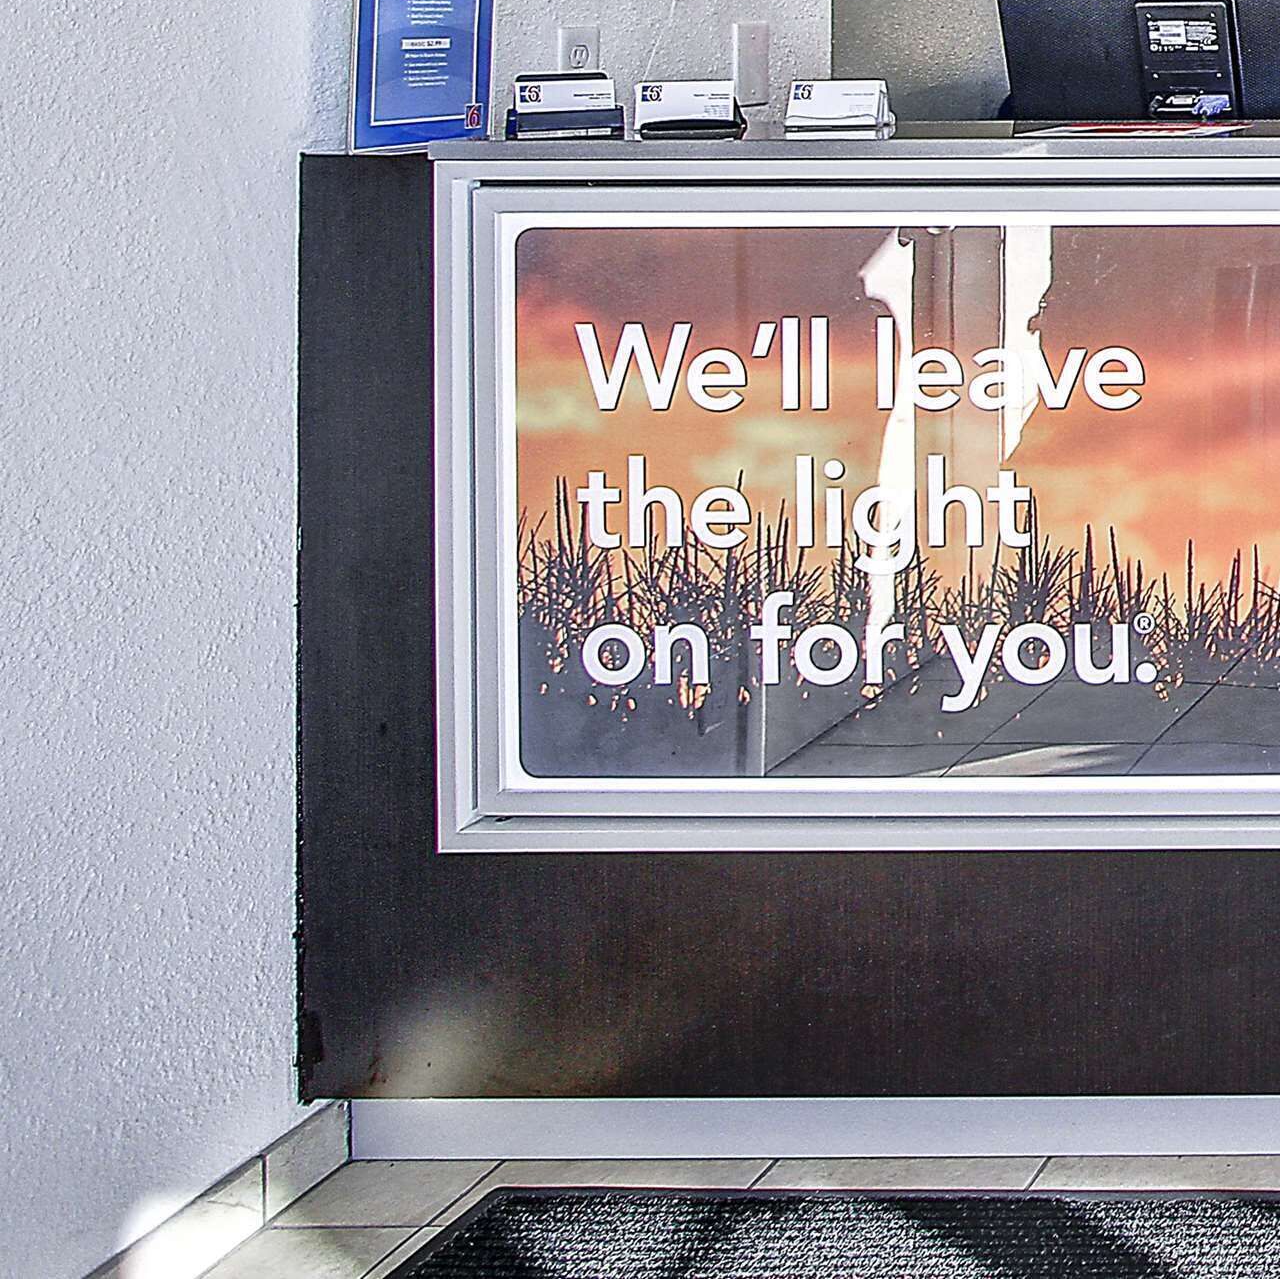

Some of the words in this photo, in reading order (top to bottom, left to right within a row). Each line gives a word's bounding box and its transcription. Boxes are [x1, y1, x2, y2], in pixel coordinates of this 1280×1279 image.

[468, 105, 481, 128] 6
[527, 85, 540, 103] 6
[574, 316, 831, 413] We'll
[875, 316, 1146, 413] leave
[576, 454, 752, 550] the
[795, 454, 1034, 577] light
[580, 620, 710, 686] on
[750, 591, 905, 686] for
